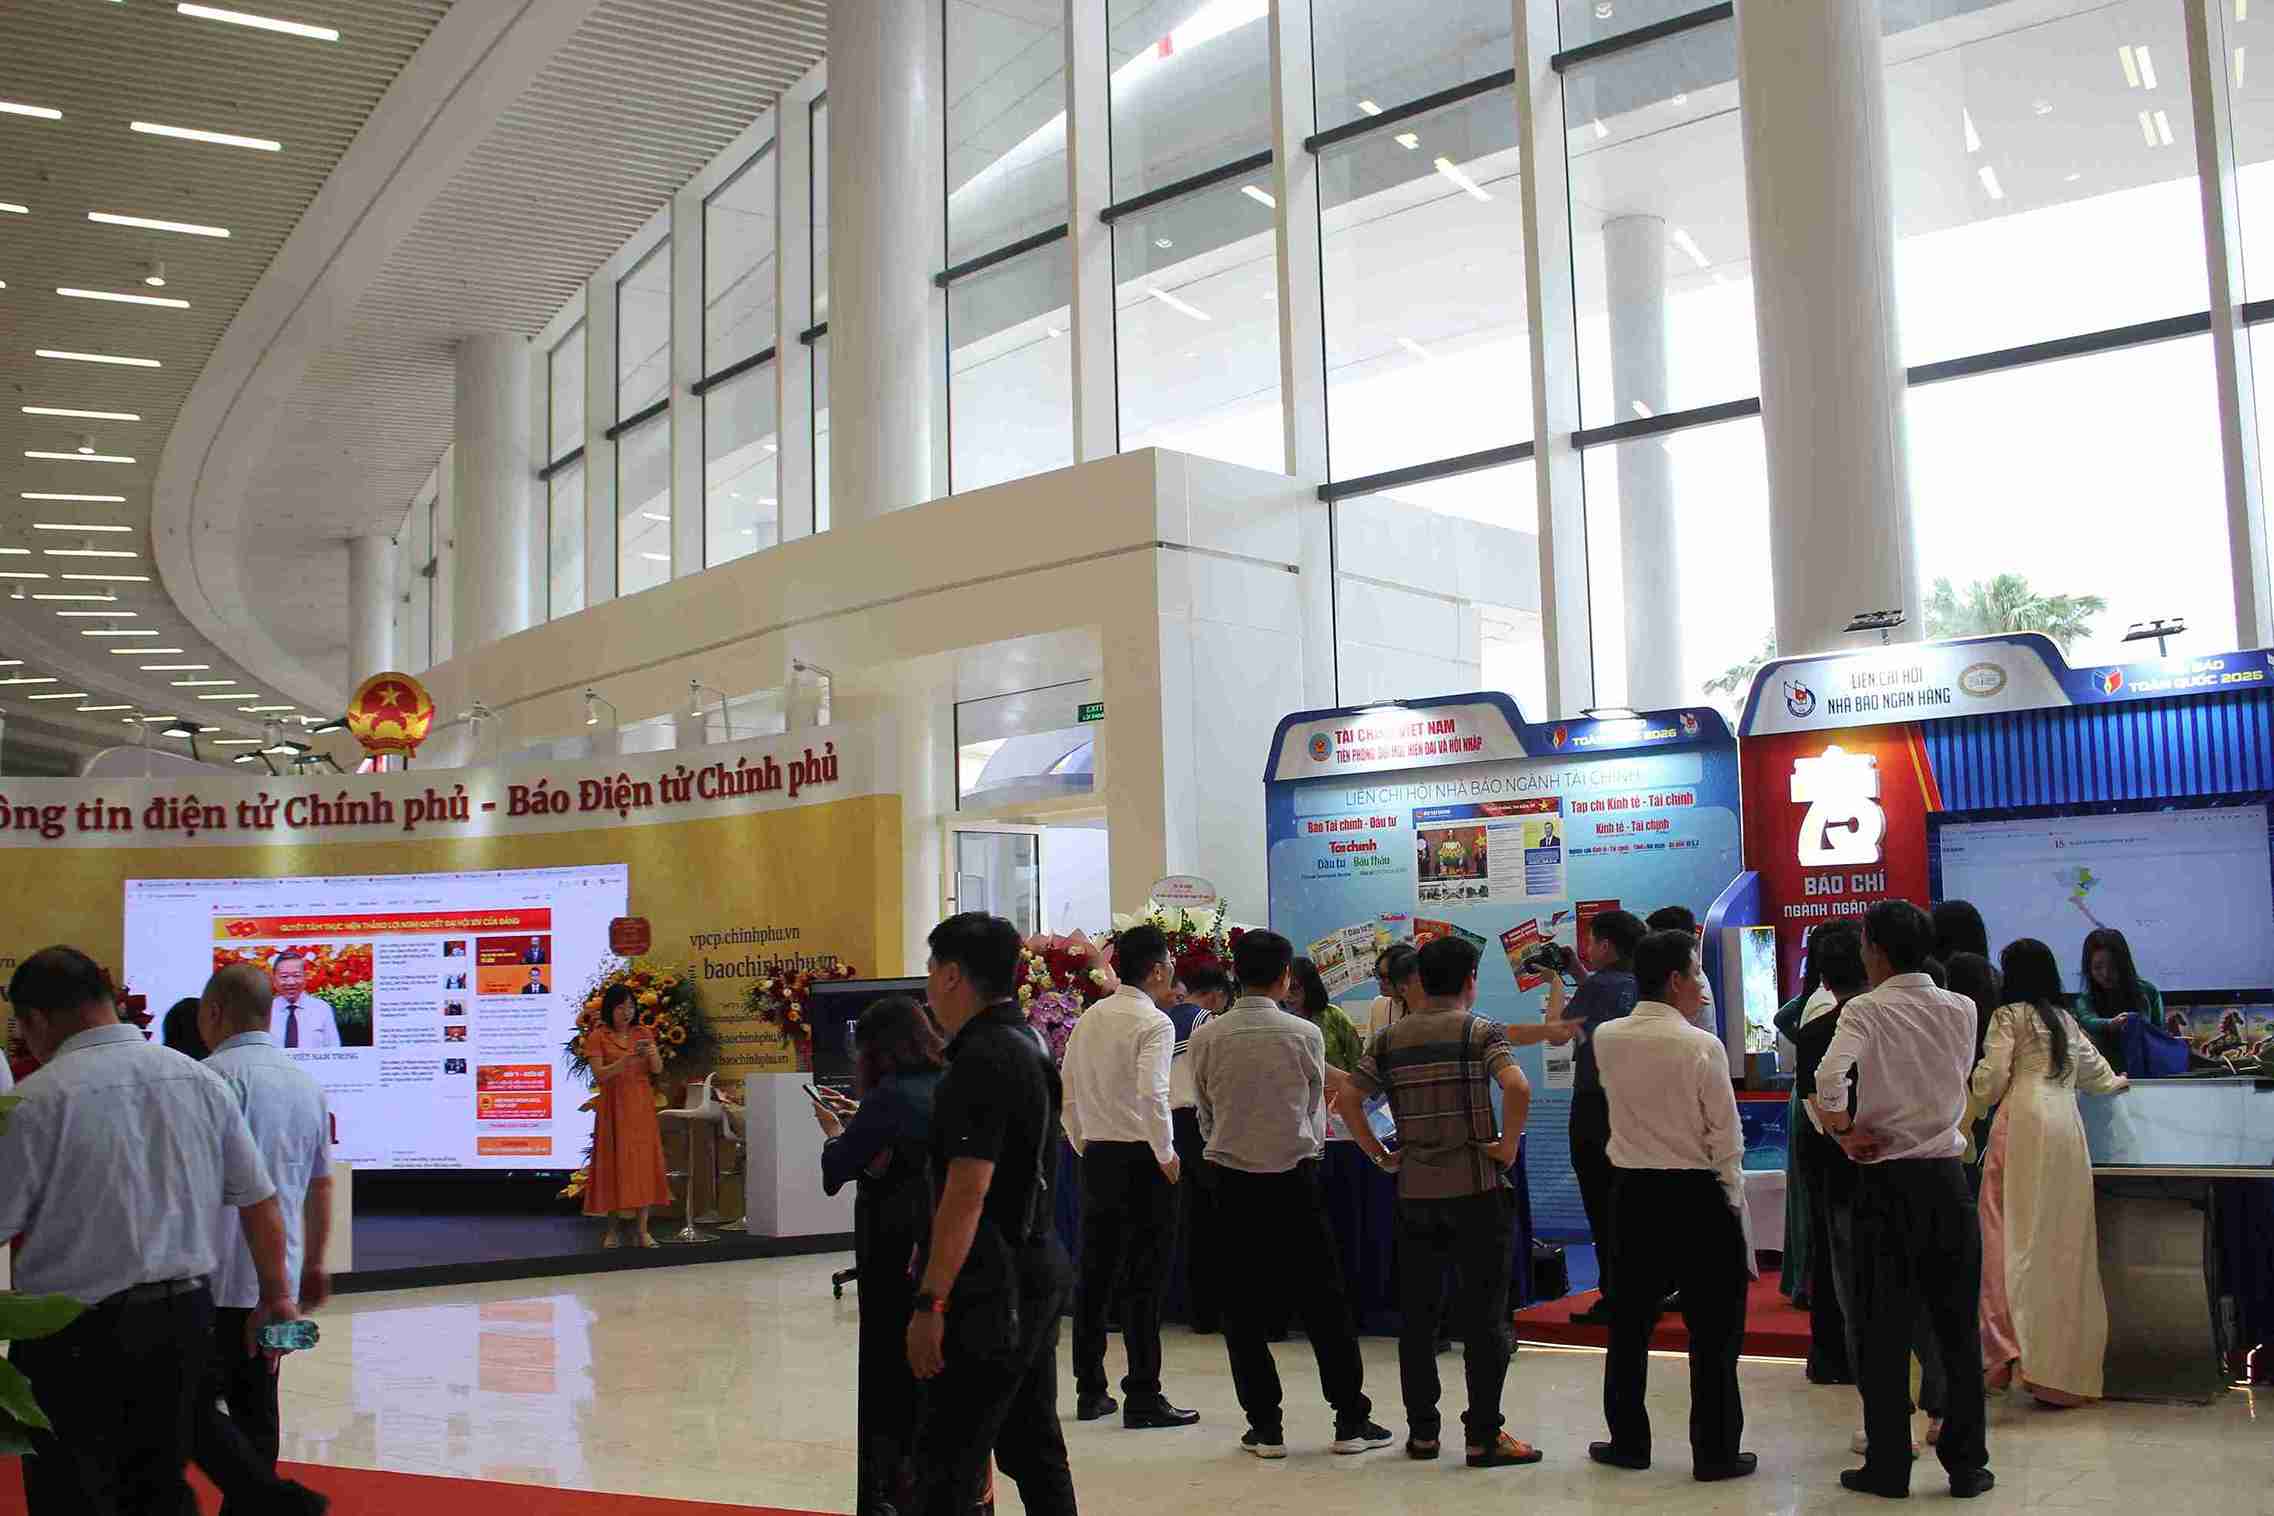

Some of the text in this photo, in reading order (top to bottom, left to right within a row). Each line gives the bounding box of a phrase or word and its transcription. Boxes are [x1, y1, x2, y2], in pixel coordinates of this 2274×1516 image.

[1427, 718, 1456, 736] NAM
[76, 797, 133, 831] tin
[143, 794, 228, 837] điện
[236, 792, 279, 829] tử
[284, 790, 394, 829] Chính
[403, 784, 470, 831] phủ
[507, 778, 570, 817] Báo
[578, 772, 654, 818] Điện
[658, 764, 695, 804] tử
[697, 756, 782, 801] Chính
[787, 742, 840, 798] phủ
[1432, 777, 1467, 799] NHÀ
[1471, 774, 1502, 796] BÁO
[1505, 771, 1560, 794] NGÀNH
[1607, 797, 1628, 811] Kinh
[1804, 868, 1885, 896] BÁO CHÍ
[690, 925, 800, 951] vpcp.chinhphu.vn
